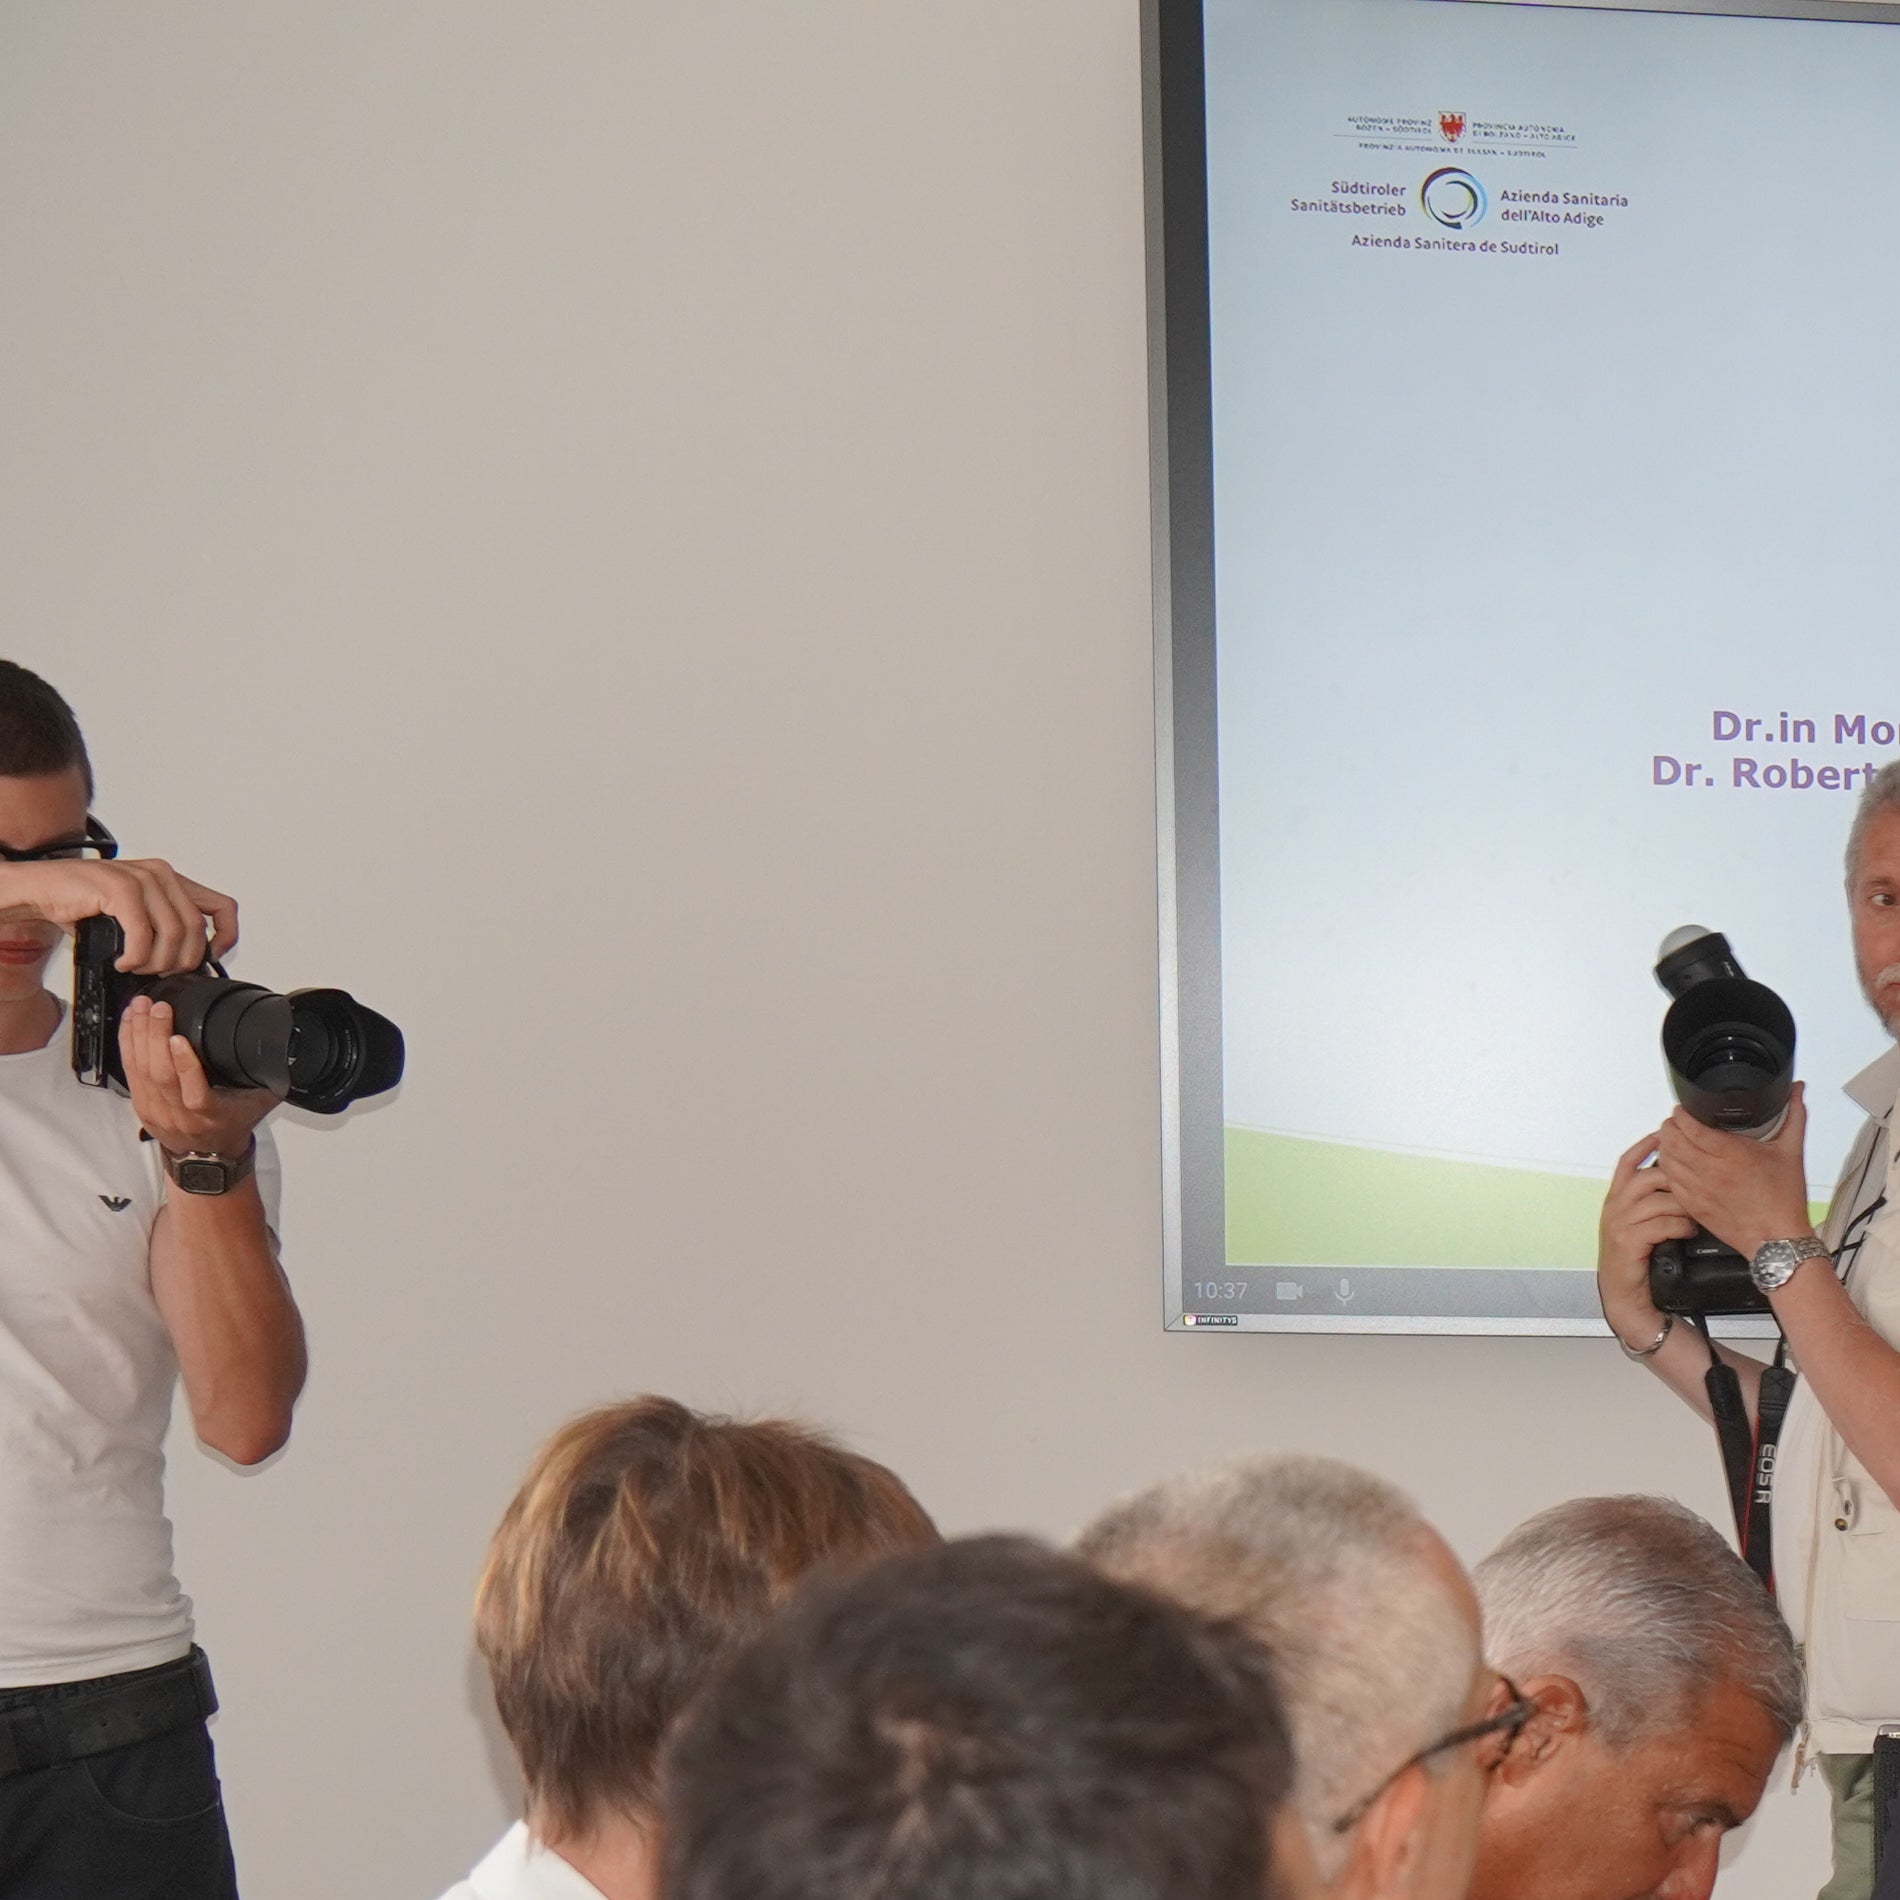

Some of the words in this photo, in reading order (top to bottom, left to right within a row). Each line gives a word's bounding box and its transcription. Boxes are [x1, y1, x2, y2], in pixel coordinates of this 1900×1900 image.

[1331, 180, 1407, 197] Südtiroler
[1499, 188, 1560, 205] Azienda
[1562, 191, 1629, 208] Sanitaria
[1290, 198, 1407, 217] Sanitätsbetrieb
[1562, 211, 1605, 229] Adige
[1351, 233, 1411, 249] Azienda
[1414, 236, 1477, 252] Sanitera
[1478, 239, 1498, 253] de
[1500, 240, 1559, 256] Sudtirol
[1713, 710, 1816, 744] Dr.in
[1652, 755, 1714, 787] Dr.
[1733, 757, 1879, 790] Robert
[1193, 1281, 1248, 1300] 10:37
[1756, 1443, 1777, 1487] EOS
[1753, 1489, 1773, 1504] R
